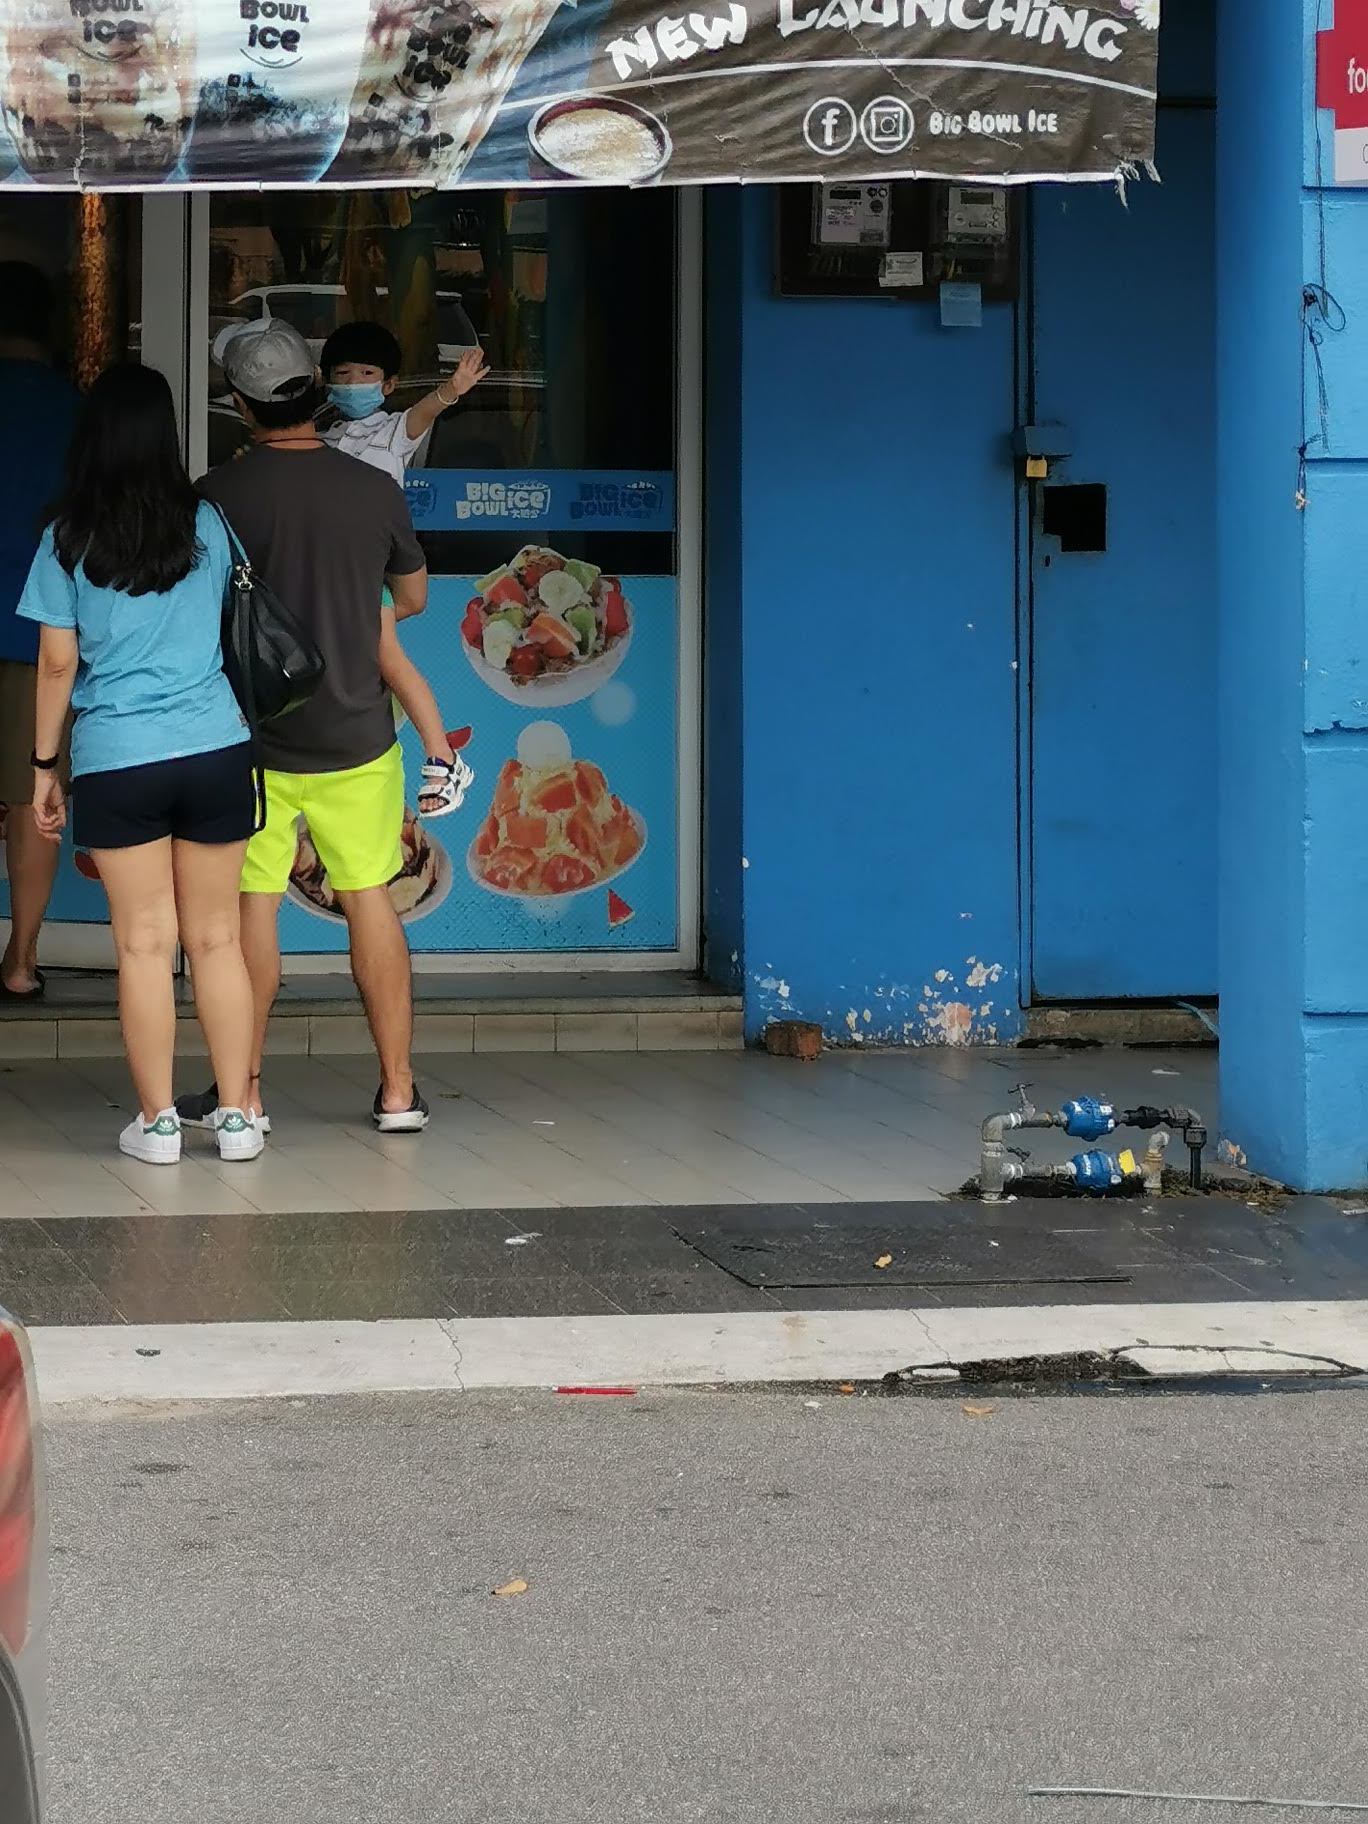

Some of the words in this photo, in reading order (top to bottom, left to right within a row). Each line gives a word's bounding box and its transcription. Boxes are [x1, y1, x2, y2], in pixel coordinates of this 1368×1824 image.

[604, 2, 748, 81] NEW
[1347, 57, 1368, 94] fo
[455, 500, 509, 520] BOWL
